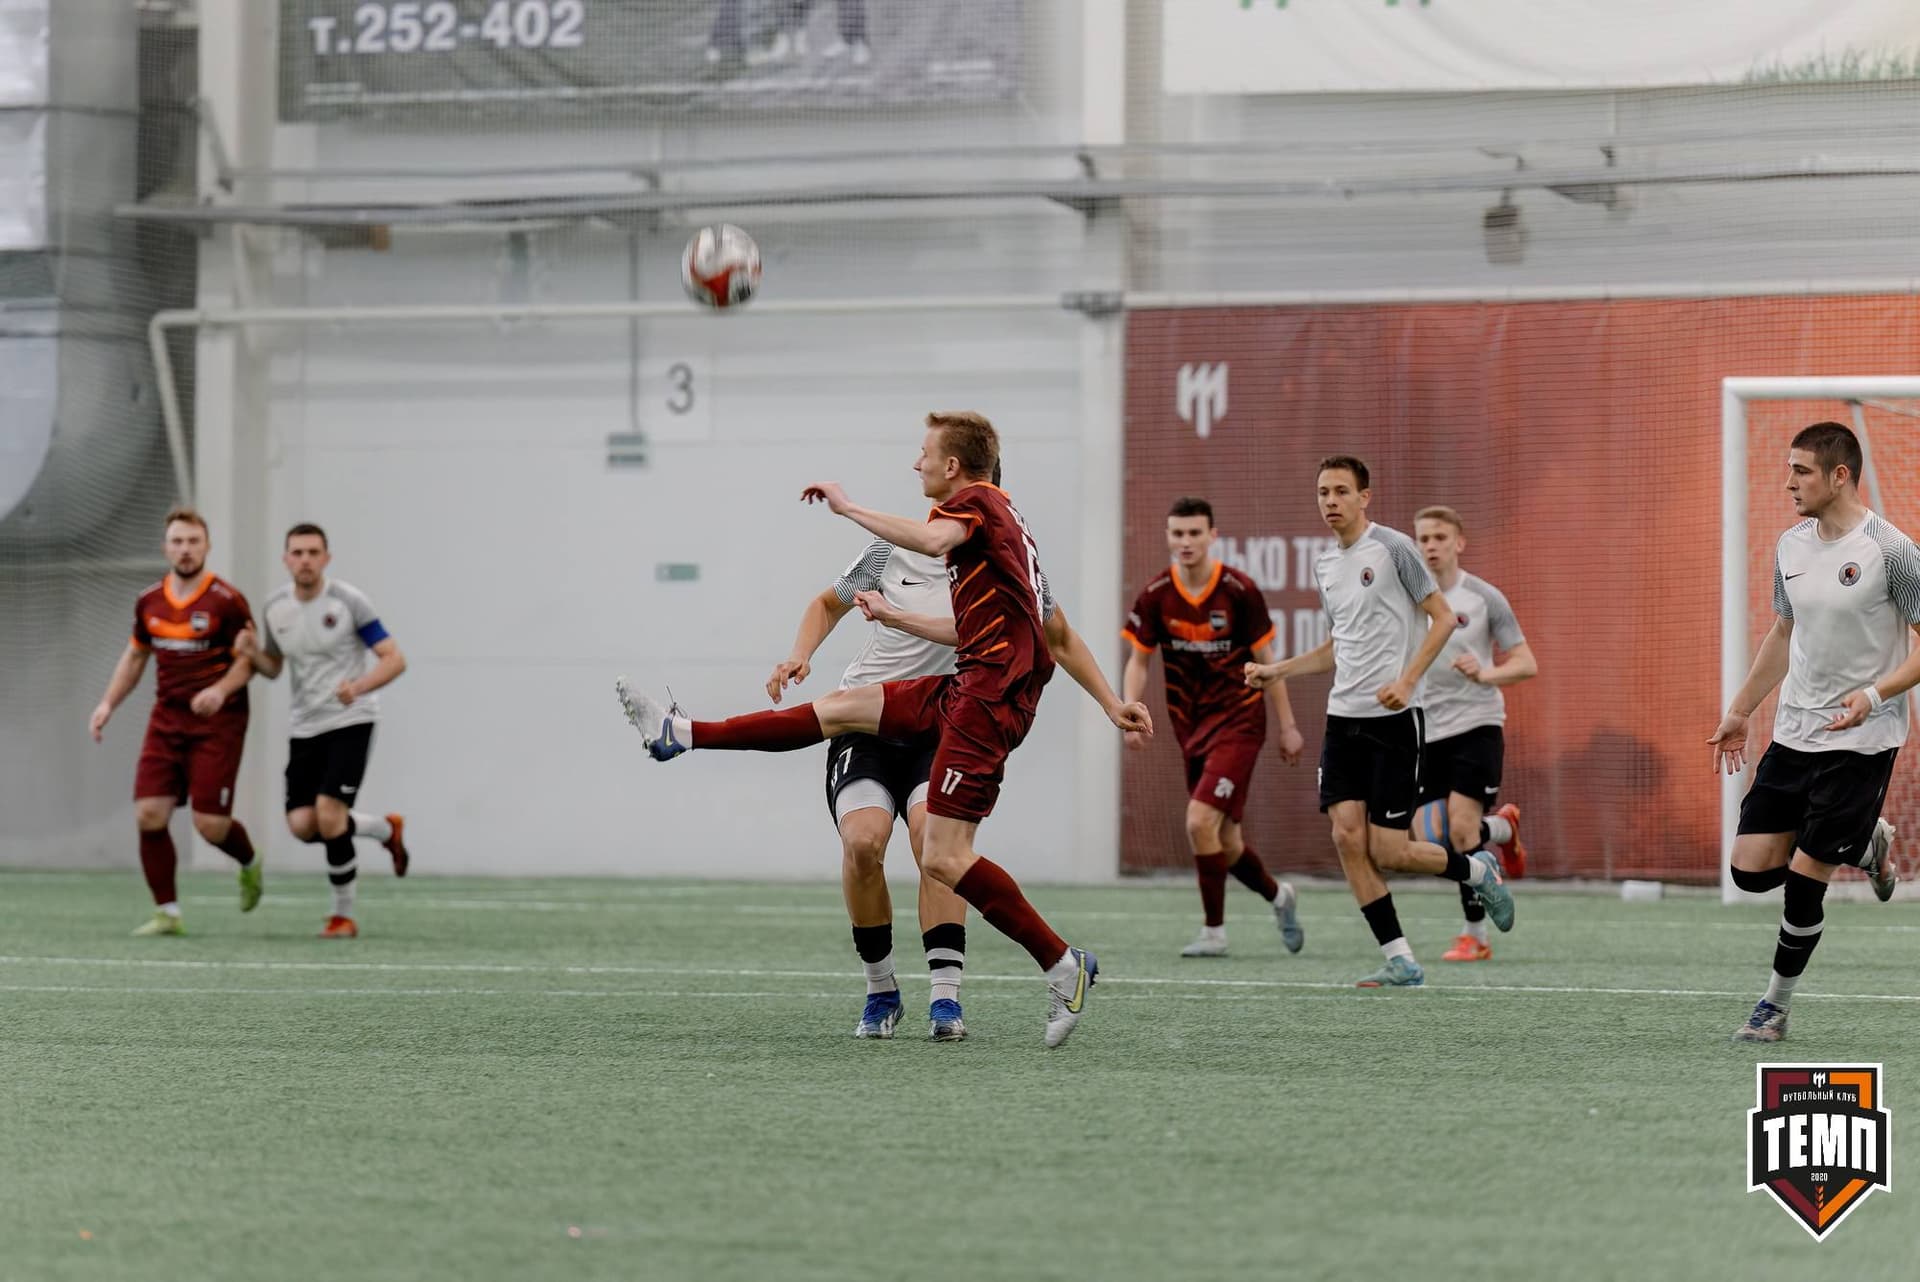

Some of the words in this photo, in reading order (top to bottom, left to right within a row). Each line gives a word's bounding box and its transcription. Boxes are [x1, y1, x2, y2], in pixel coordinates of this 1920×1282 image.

[308, 0, 585, 54] т.252-402
[667, 362, 695, 416] 3
[941, 768, 963, 795] 17
